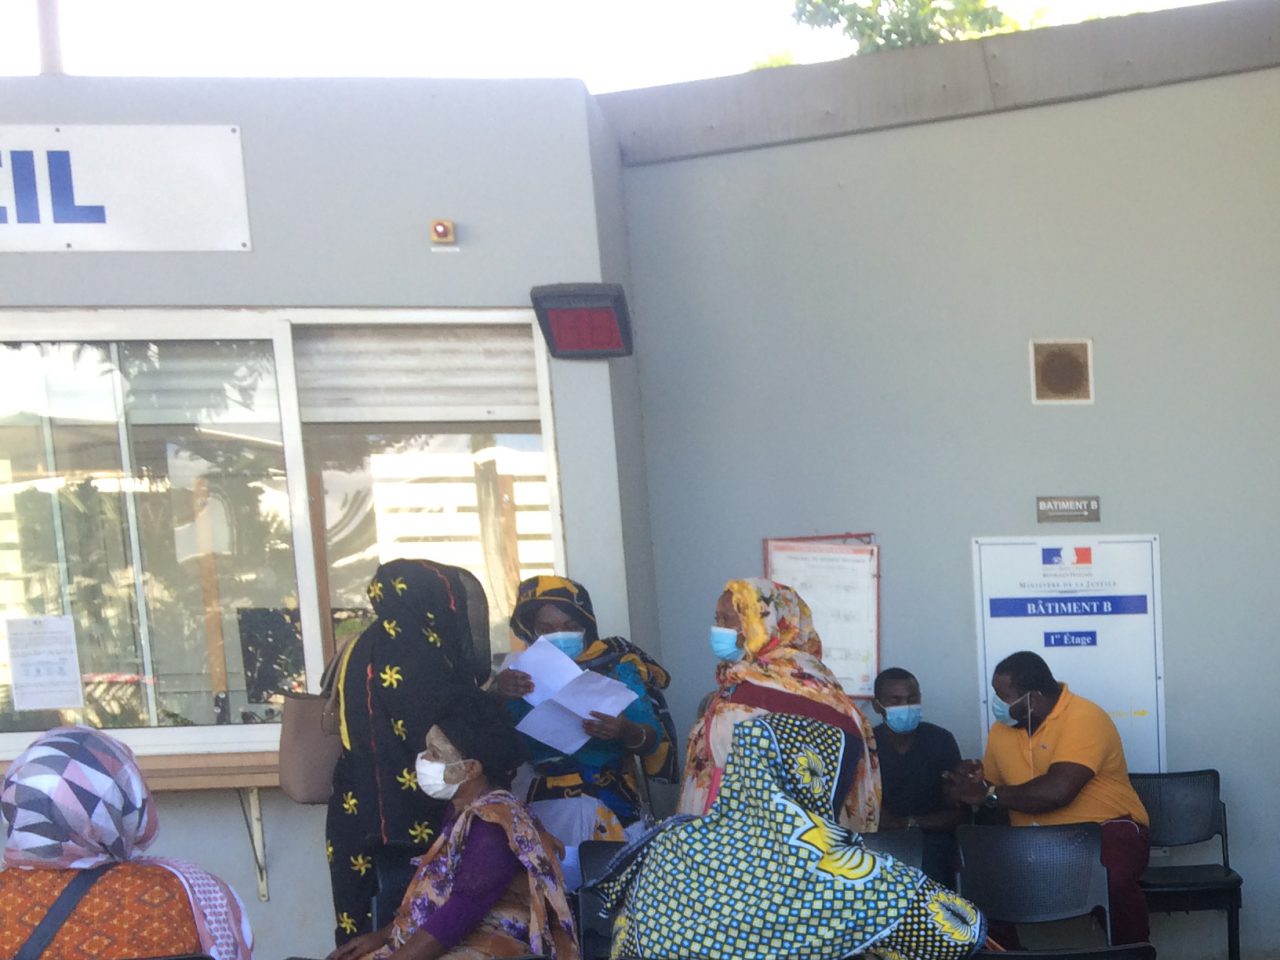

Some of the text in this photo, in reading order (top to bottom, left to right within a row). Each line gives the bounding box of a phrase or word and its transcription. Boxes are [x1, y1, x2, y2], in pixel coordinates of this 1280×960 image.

[0, 150, 107, 224] IL
[1090, 500, 1098, 510] B
[1027, 600, 1113, 614] BÂTIMENT B
